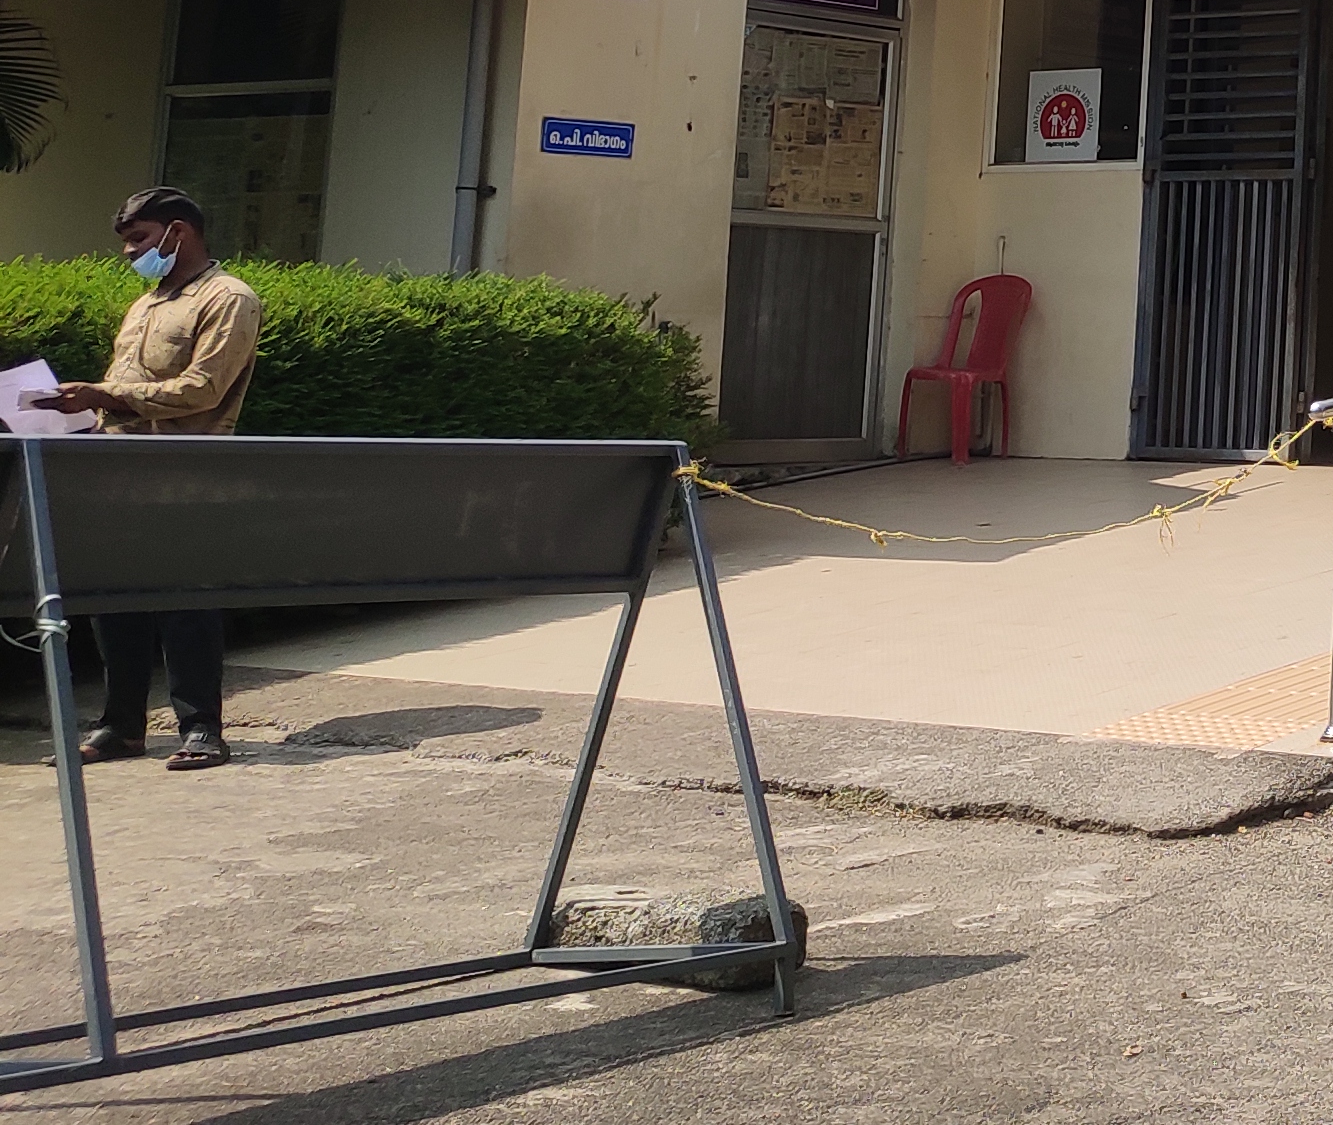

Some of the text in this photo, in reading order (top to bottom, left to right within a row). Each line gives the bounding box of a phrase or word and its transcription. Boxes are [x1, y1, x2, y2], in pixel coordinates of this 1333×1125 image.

[1033, 84, 1094, 133] NATIONAL HEALTH MISSION
